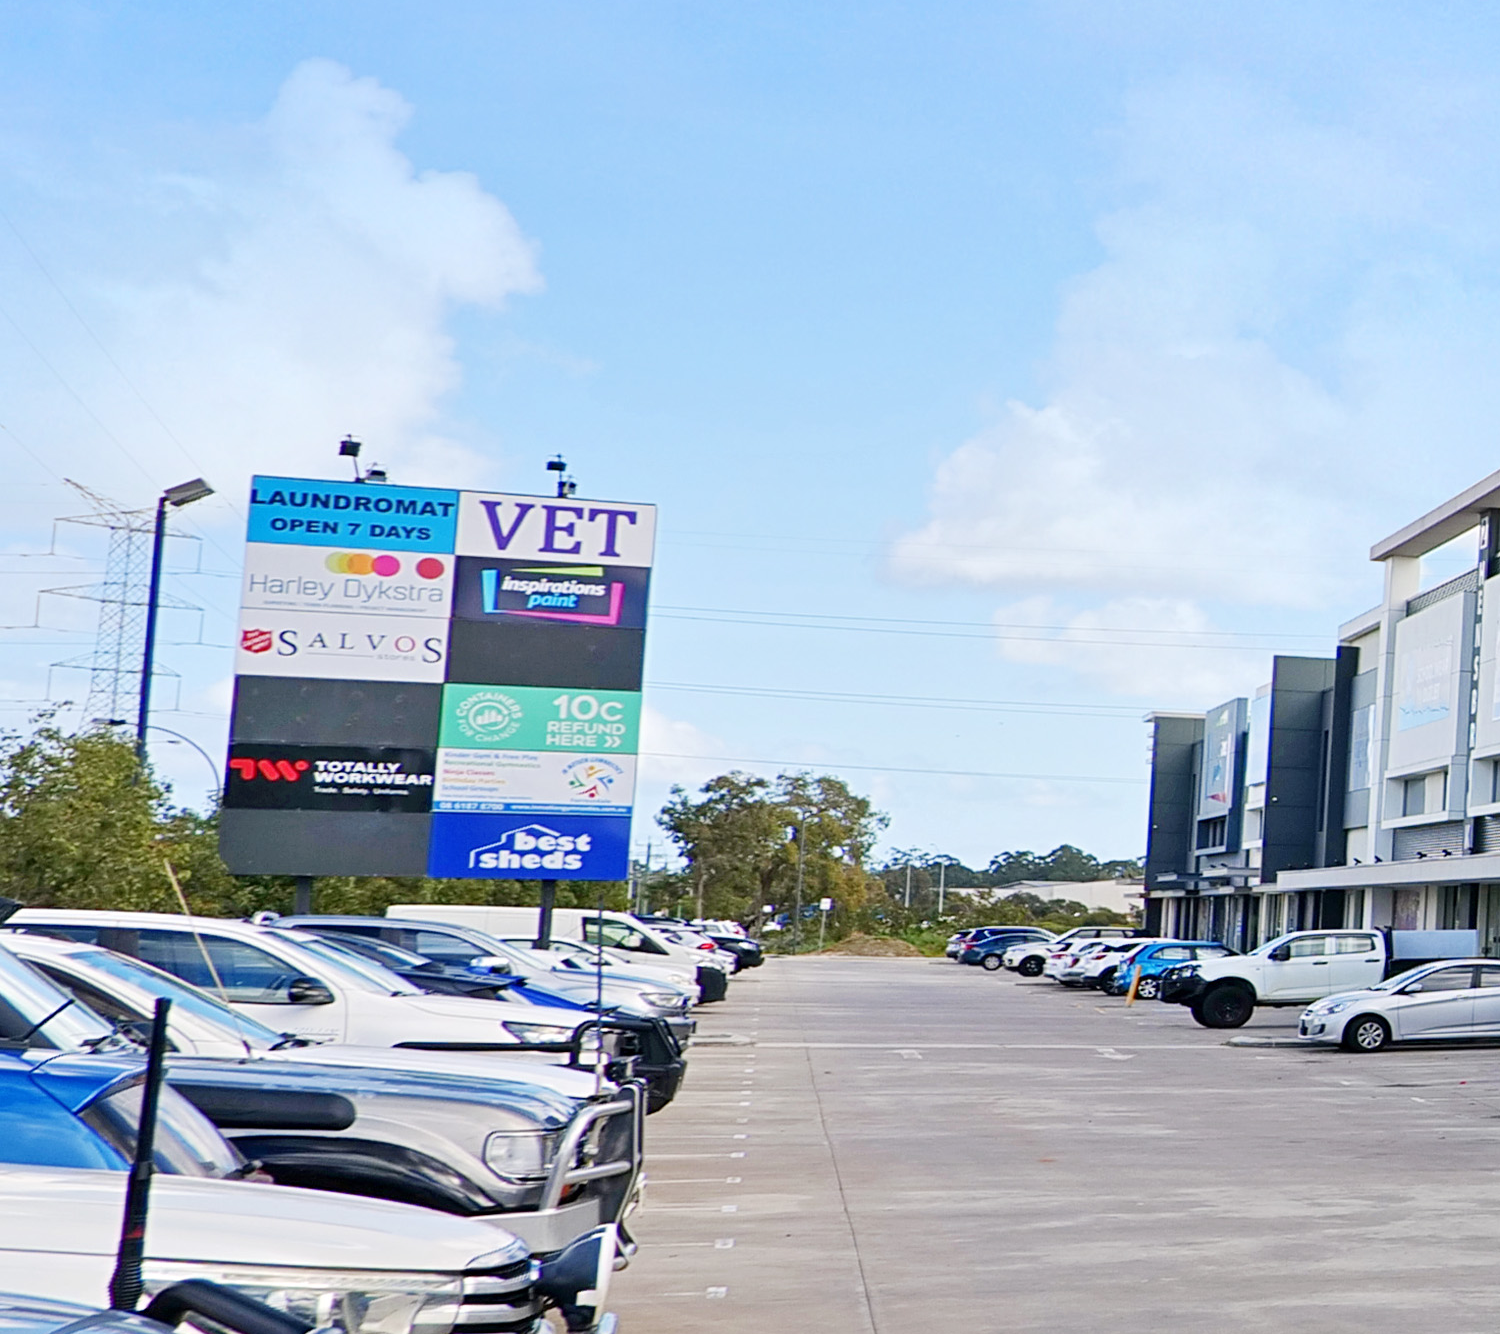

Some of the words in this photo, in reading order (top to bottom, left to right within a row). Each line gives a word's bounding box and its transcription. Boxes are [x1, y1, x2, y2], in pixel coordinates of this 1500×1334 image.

[251, 489, 455, 517] LAUNDROMAT
[271, 518, 338, 534] OPEN
[347, 523, 361, 535] 7
[370, 525, 431, 541] DAYS
[479, 500, 637, 557] VET
[249, 574, 334, 601] Harley
[344, 578, 443, 603] Dykstra
[502, 576, 606, 596] inspirations
[527, 593, 578, 609] paint
[277, 630, 443, 664] SALVOS
[456, 692, 524, 719] CONTAINERS
[456, 719, 475, 738] FOR
[475, 721, 521, 742] CHANGE
[547, 721, 626, 735] REFUND
[546, 735, 597, 747] HERE
[314, 761, 401, 774] TOTALLY
[313, 772, 434, 786] WORKWEAR
[513, 831, 592, 852] best
[479, 850, 583, 870] sheds
